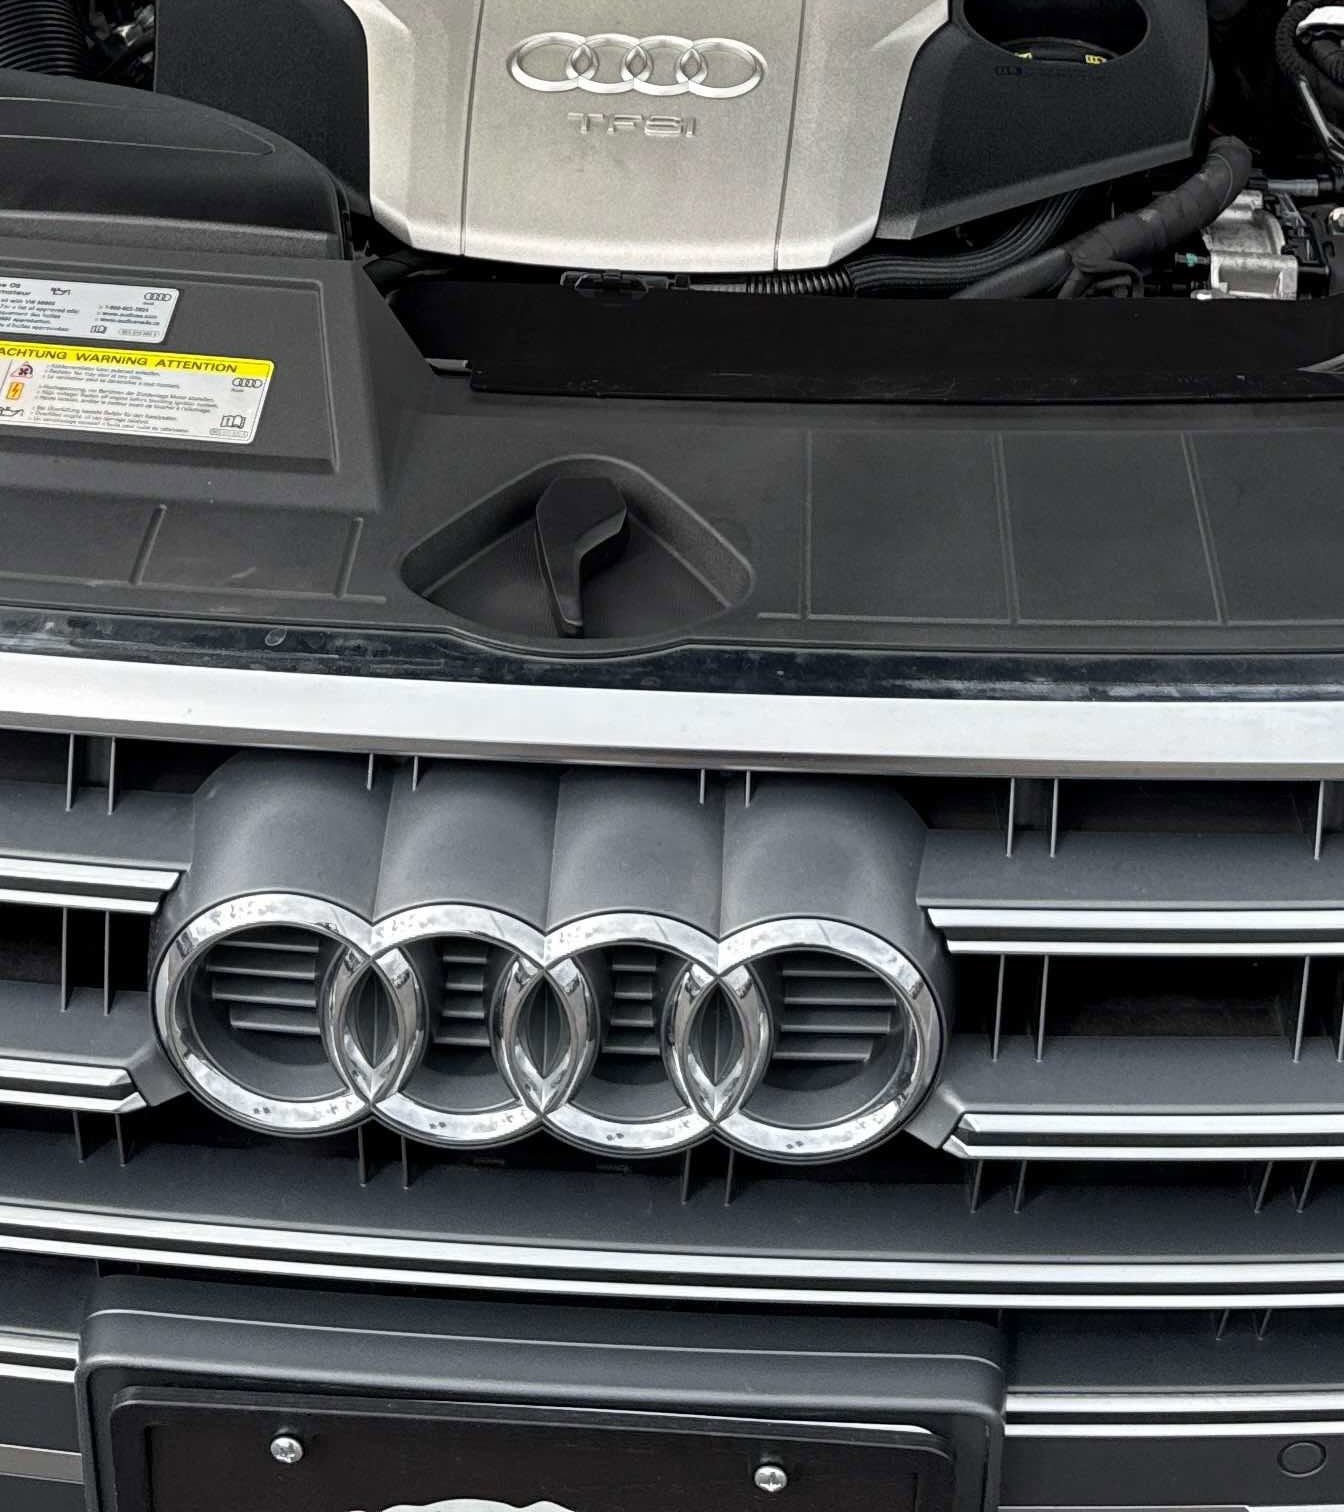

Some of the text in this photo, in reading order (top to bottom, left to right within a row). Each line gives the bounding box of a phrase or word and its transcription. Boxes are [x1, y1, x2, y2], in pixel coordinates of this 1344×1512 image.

[567, 113, 697, 138] TFSI
[76, 353, 148, 366] WARNING
[156, 359, 238, 373] ATTENTION
